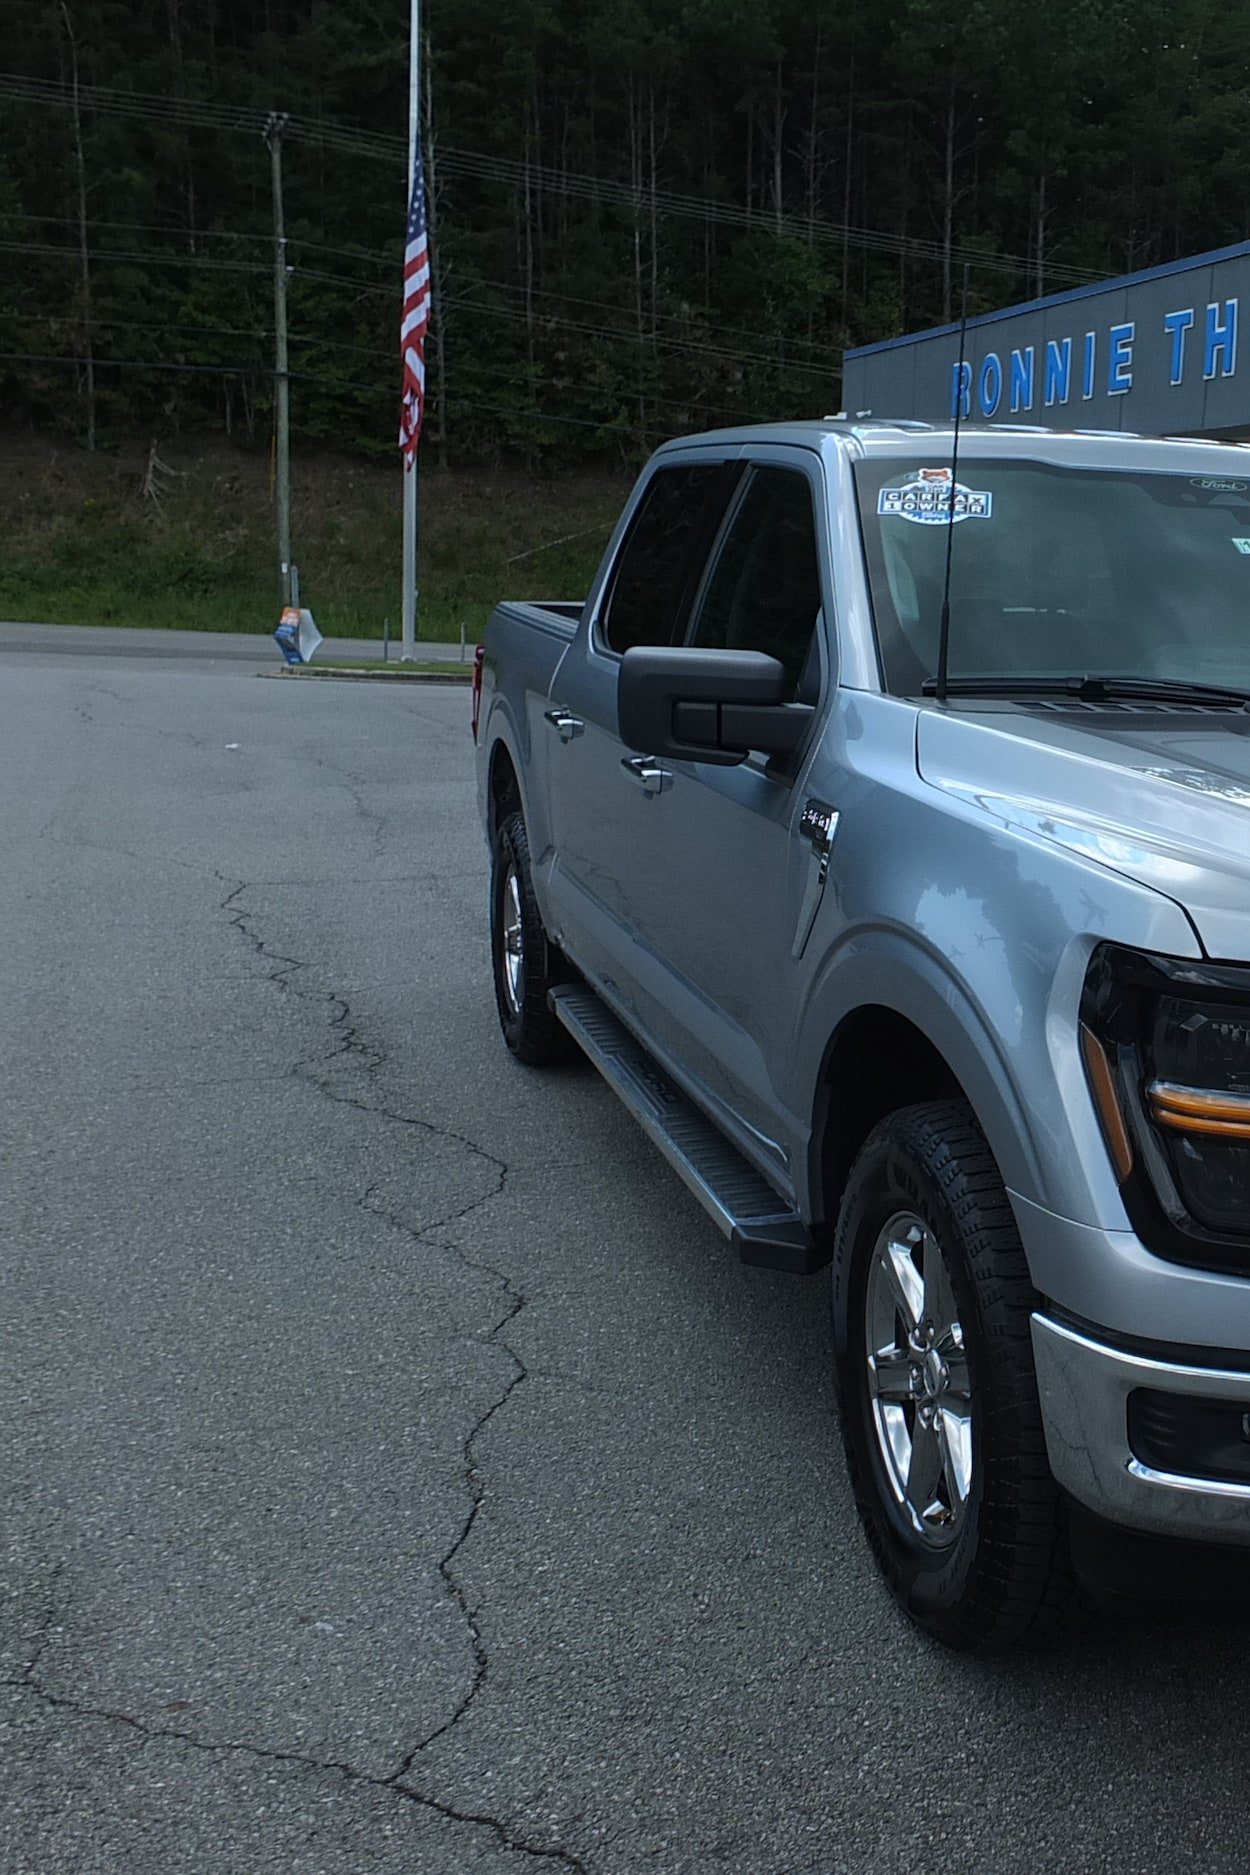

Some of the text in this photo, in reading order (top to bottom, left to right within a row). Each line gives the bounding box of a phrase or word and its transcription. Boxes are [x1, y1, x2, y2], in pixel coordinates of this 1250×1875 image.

[950, 321, 1135, 421] RONNIE
[888, 493, 983, 504] CARFAX
[903, 503, 982, 513] OWNER
